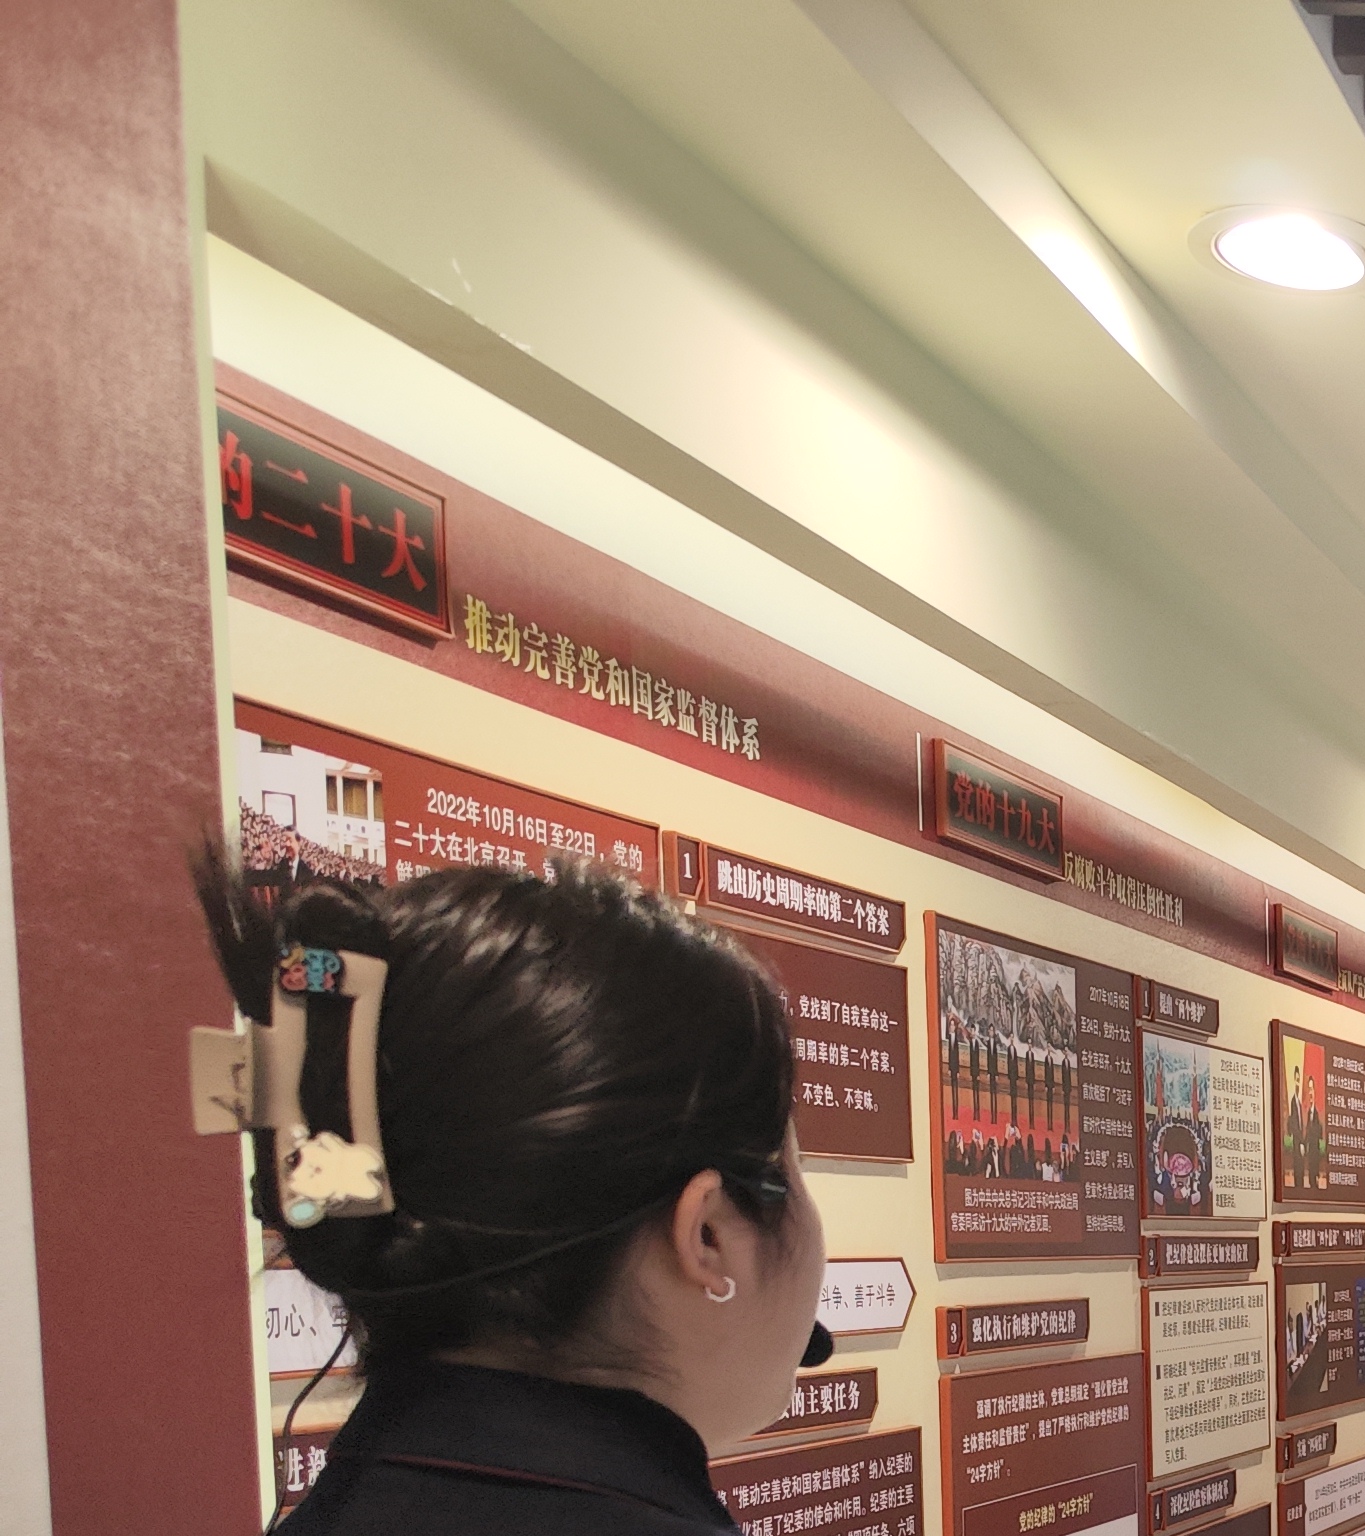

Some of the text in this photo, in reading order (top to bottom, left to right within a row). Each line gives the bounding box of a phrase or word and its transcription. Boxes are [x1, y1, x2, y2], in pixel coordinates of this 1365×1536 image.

[464, 593, 762, 762] 推动完善党和国家监督体系
[427, 787, 643, 872] 2022年10月16日至22日，党的
[951, 770, 1055, 856] 党的十九大
[682, 849, 696, 883] 1
[717, 859, 890, 936] 跳出历史周期率的第二个答案
[1063, 851, 1184, 928] 反腐败斗争取得压倒性胜利
[1165, 1242, 1250, 1266] 把纪律建设摆在更加突出位置
[820, 1283, 897, 1310] 斗争、善于斗争
[949, 1322, 958, 1344] 3
[972, 1309, 1077, 1344] 强化执行和维护党的纪律
[1018, 1492, 1095, 1534] 党的纪律的“24字方针”
